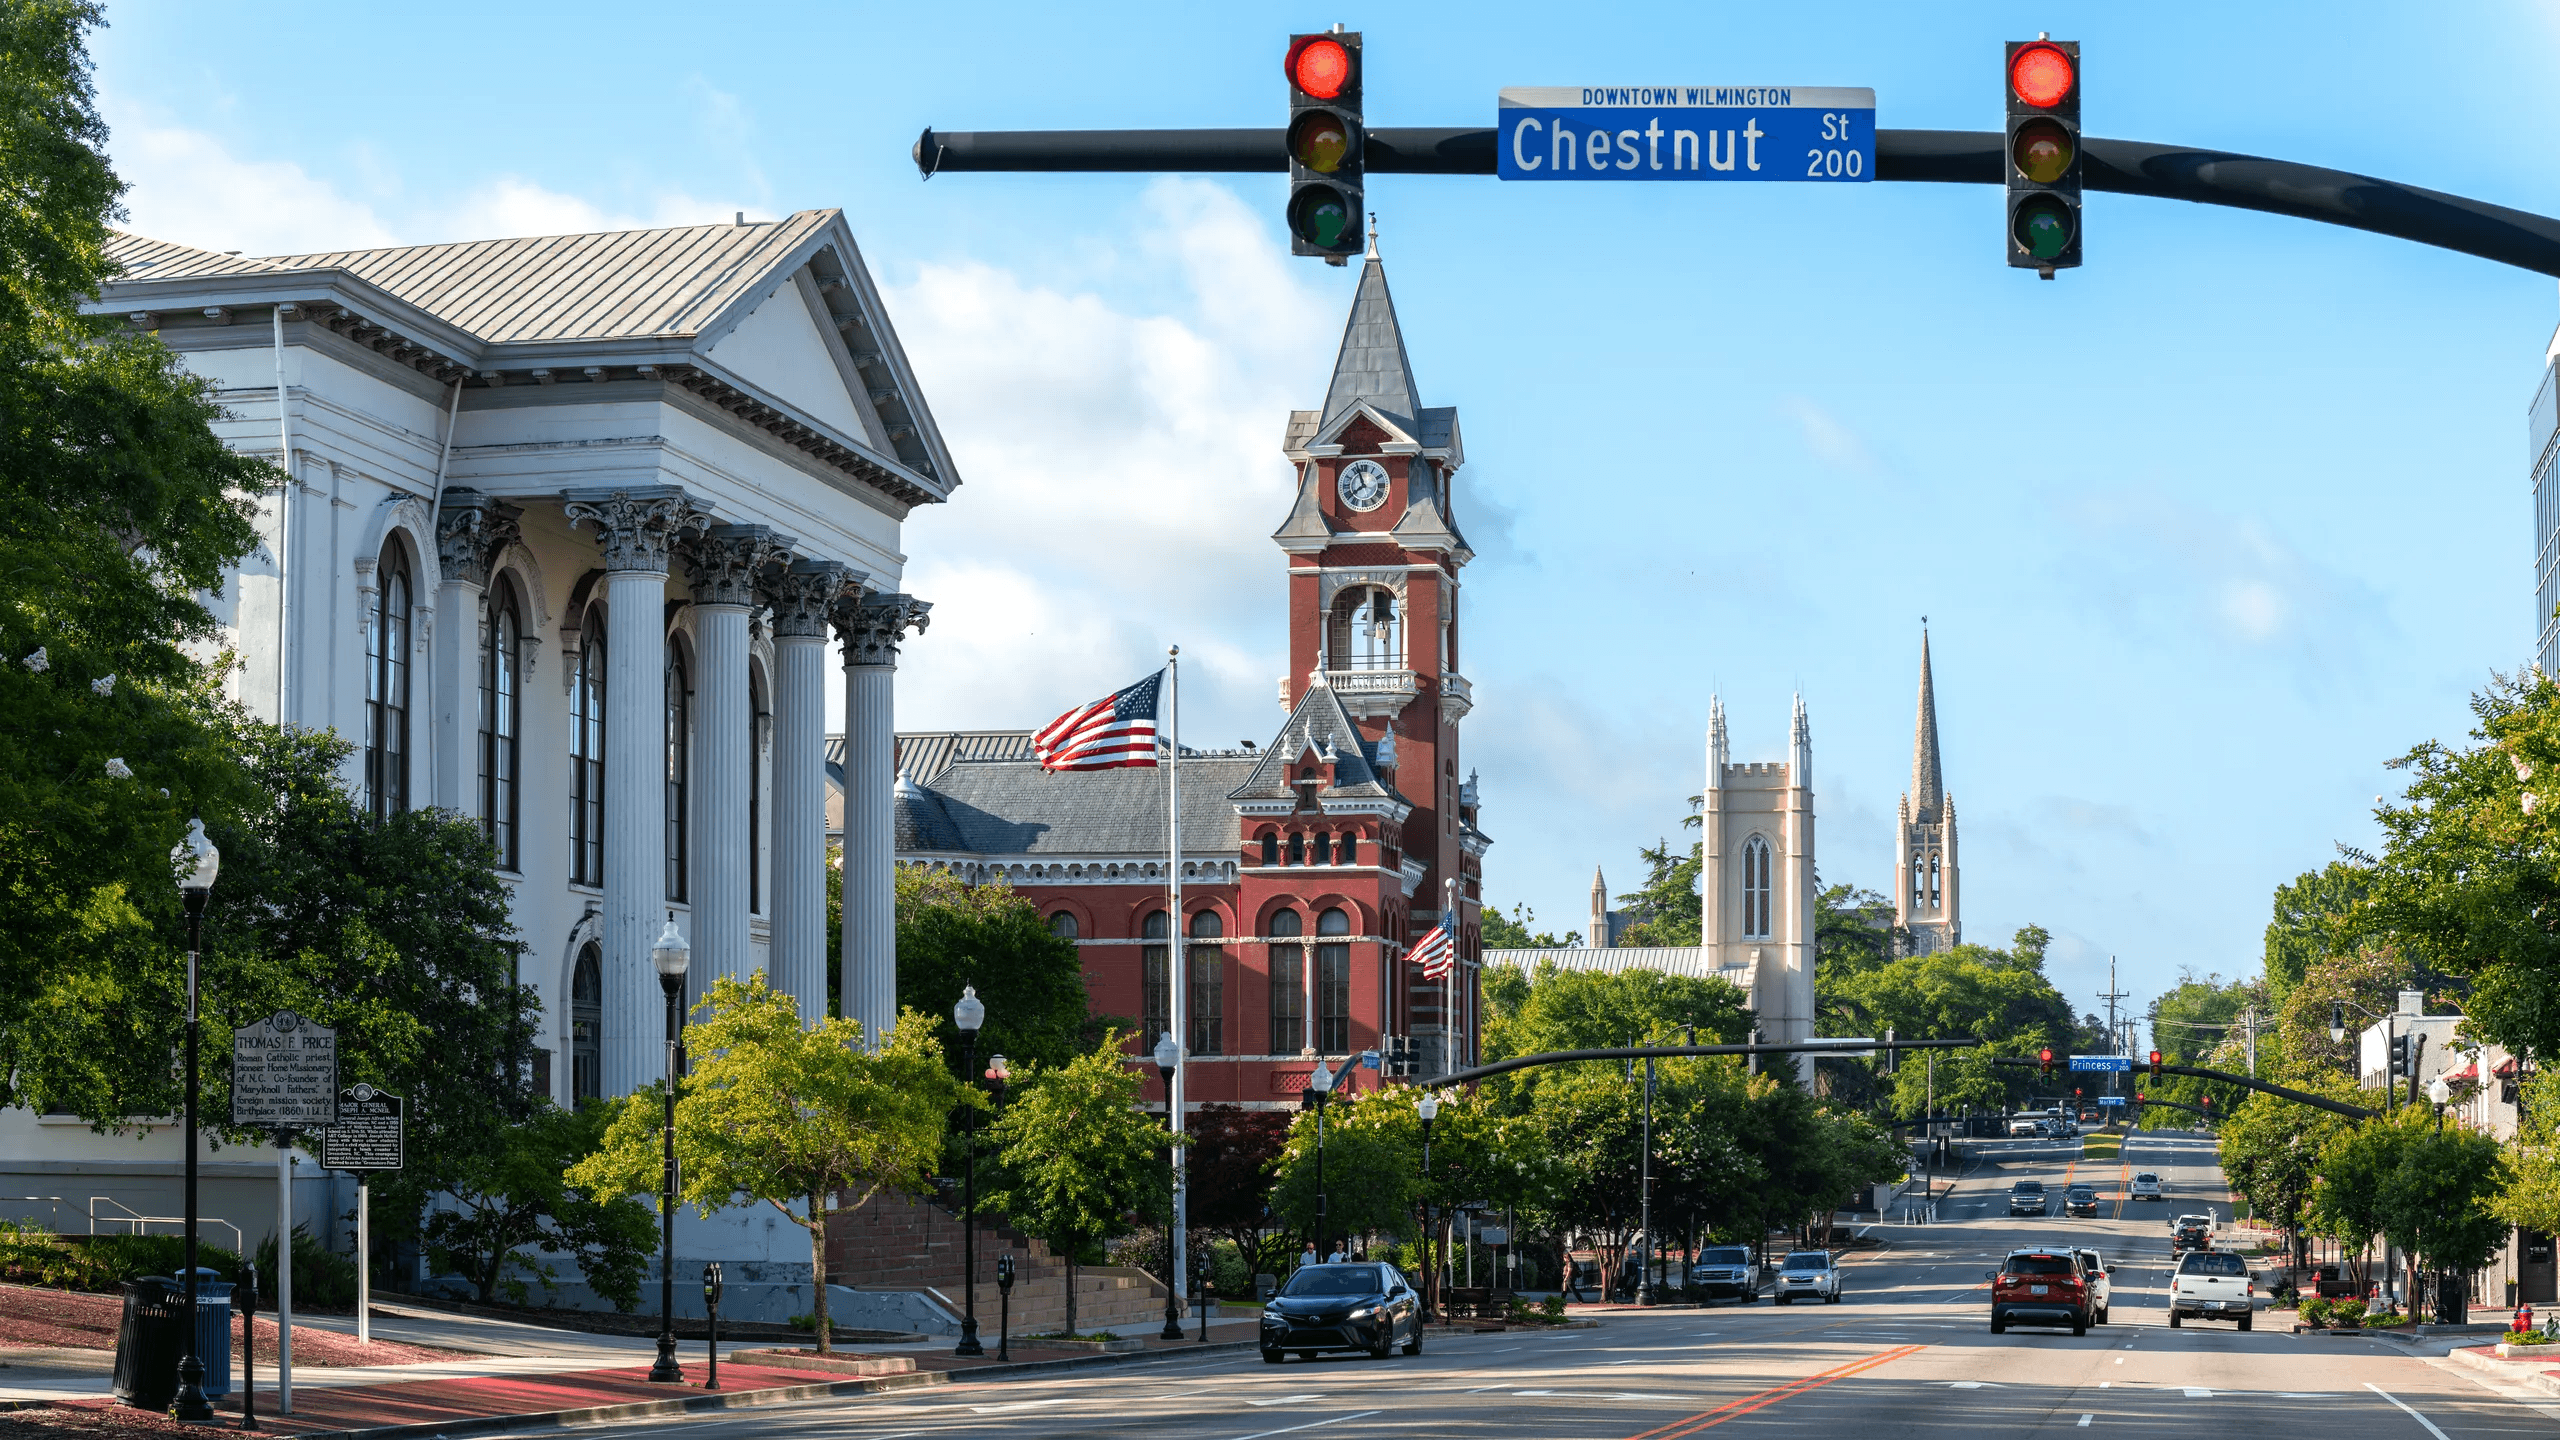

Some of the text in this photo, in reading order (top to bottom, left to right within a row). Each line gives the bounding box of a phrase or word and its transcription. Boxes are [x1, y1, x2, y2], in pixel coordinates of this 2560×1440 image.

[1582, 88, 1792, 106] DOWNTOWN WILMINGTON
[1513, 113, 1850, 171] Chestnut St
[1807, 149, 1863, 178] 200
[238, 1036, 332, 1048] THOMAS F. PRICE
[238, 1052, 262, 1061] Roman
[266, 1052, 300, 1061] Catholic
[237, 1063, 332, 1073] pioneer Home Missionary
[2072, 1060, 2111, 1070] Princess
[236, 1074, 246, 1082] of
[274, 1074, 319, 1082] Co-founder
[322, 1074, 332, 1082] of
[237, 1096, 264, 1106] foreign
[237, 1106, 276, 1117] Birthplace
[279, 1106, 303, 1115] (1860)
